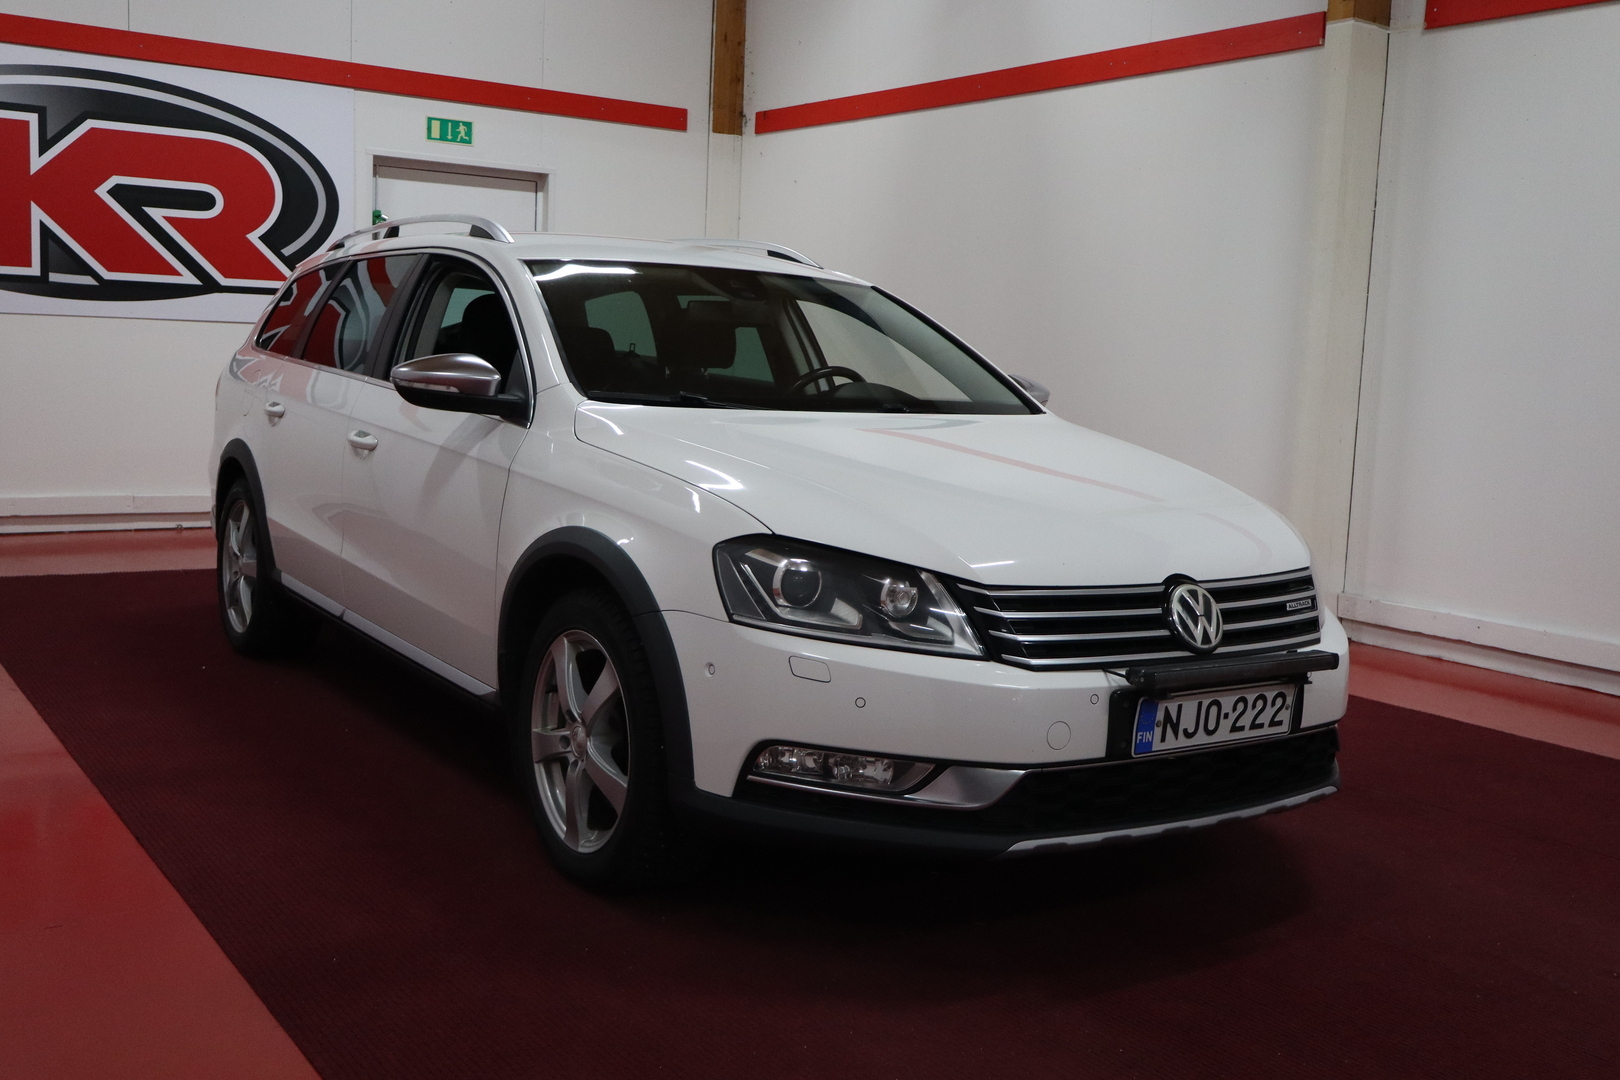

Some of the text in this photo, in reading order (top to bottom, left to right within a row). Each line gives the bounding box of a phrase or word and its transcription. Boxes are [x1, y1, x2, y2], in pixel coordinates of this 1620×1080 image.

[1171, 585, 1221, 648] VW
[1136, 730, 1153, 744] FIN
[1160, 691, 1288, 743] NJO-222
